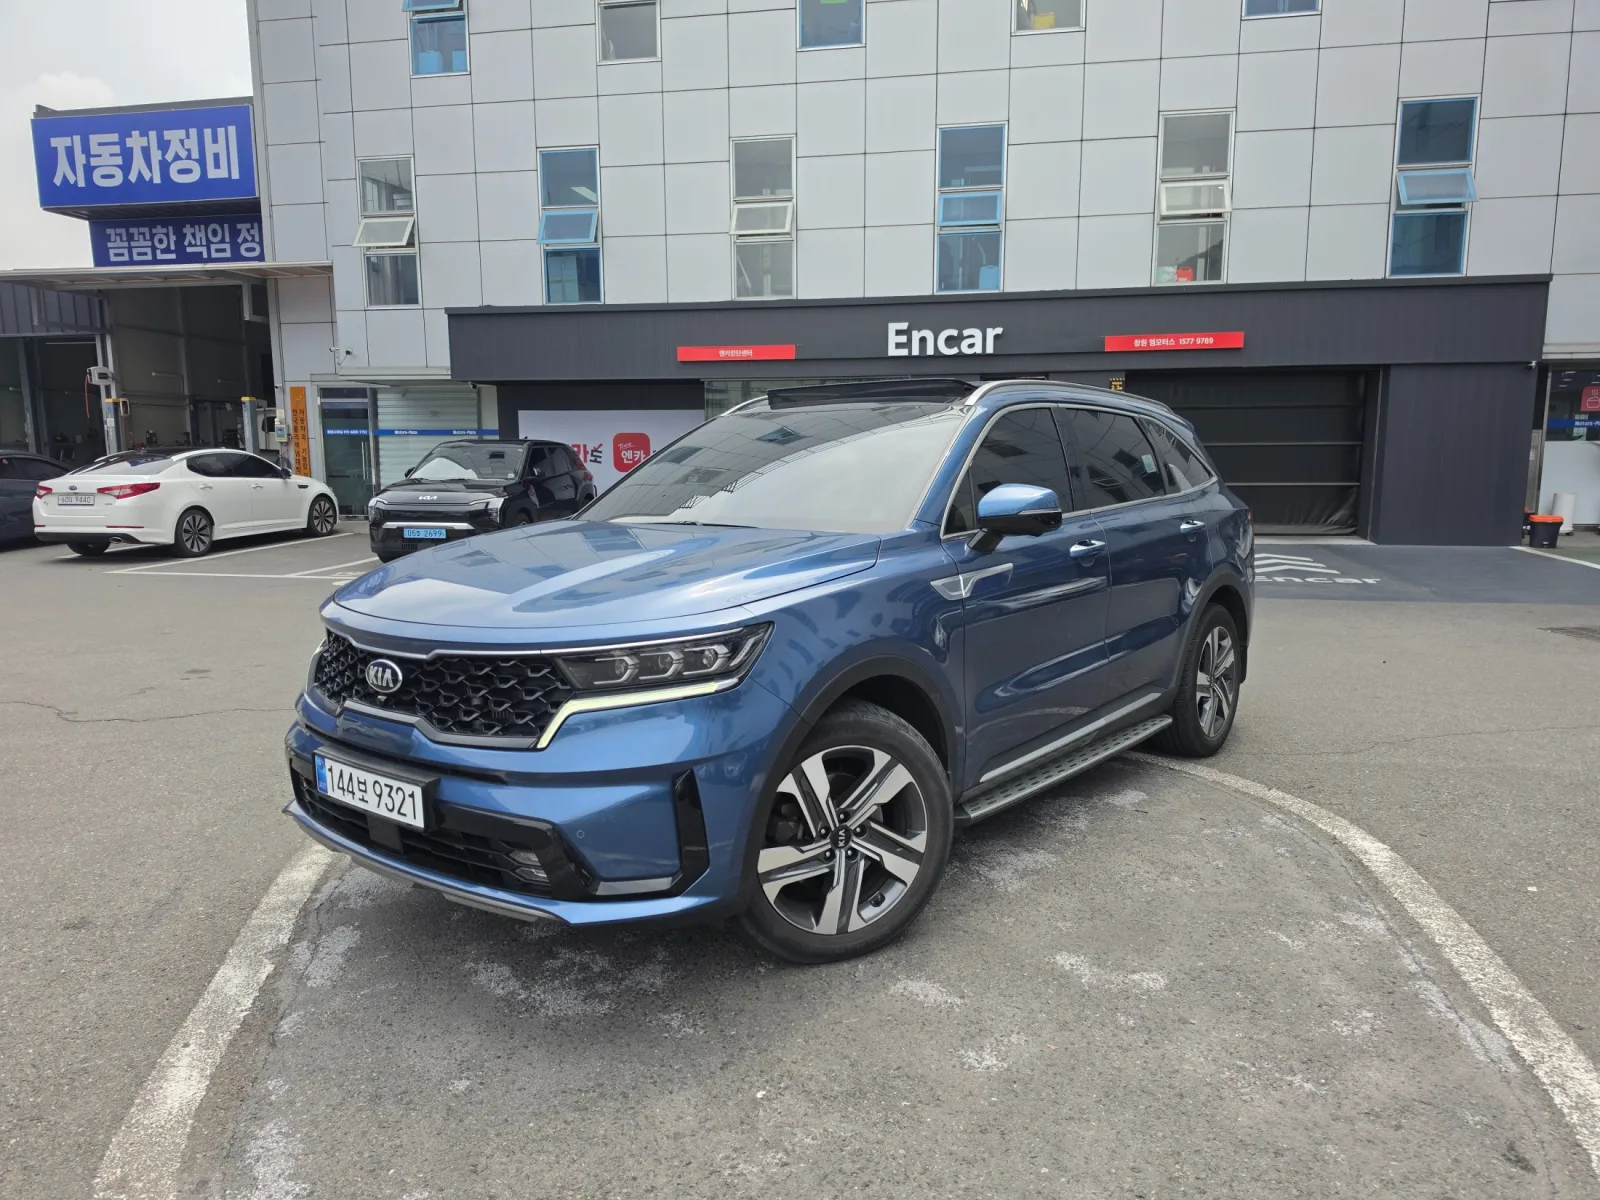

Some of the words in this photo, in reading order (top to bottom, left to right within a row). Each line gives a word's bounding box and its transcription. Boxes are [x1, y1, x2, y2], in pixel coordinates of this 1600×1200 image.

[50, 125, 240, 188] 자동차정비
[106, 225, 177, 261] 꼼꼼한
[183, 223, 232, 259] 책임
[237, 222, 261, 257] 정
[888, 322, 1004, 356] Encar
[1133, 339, 1147, 347] 창원
[1179, 337, 1194, 345] 1577
[621, 449, 646, 464] 엔카
[369, 665, 394, 687] KIA
